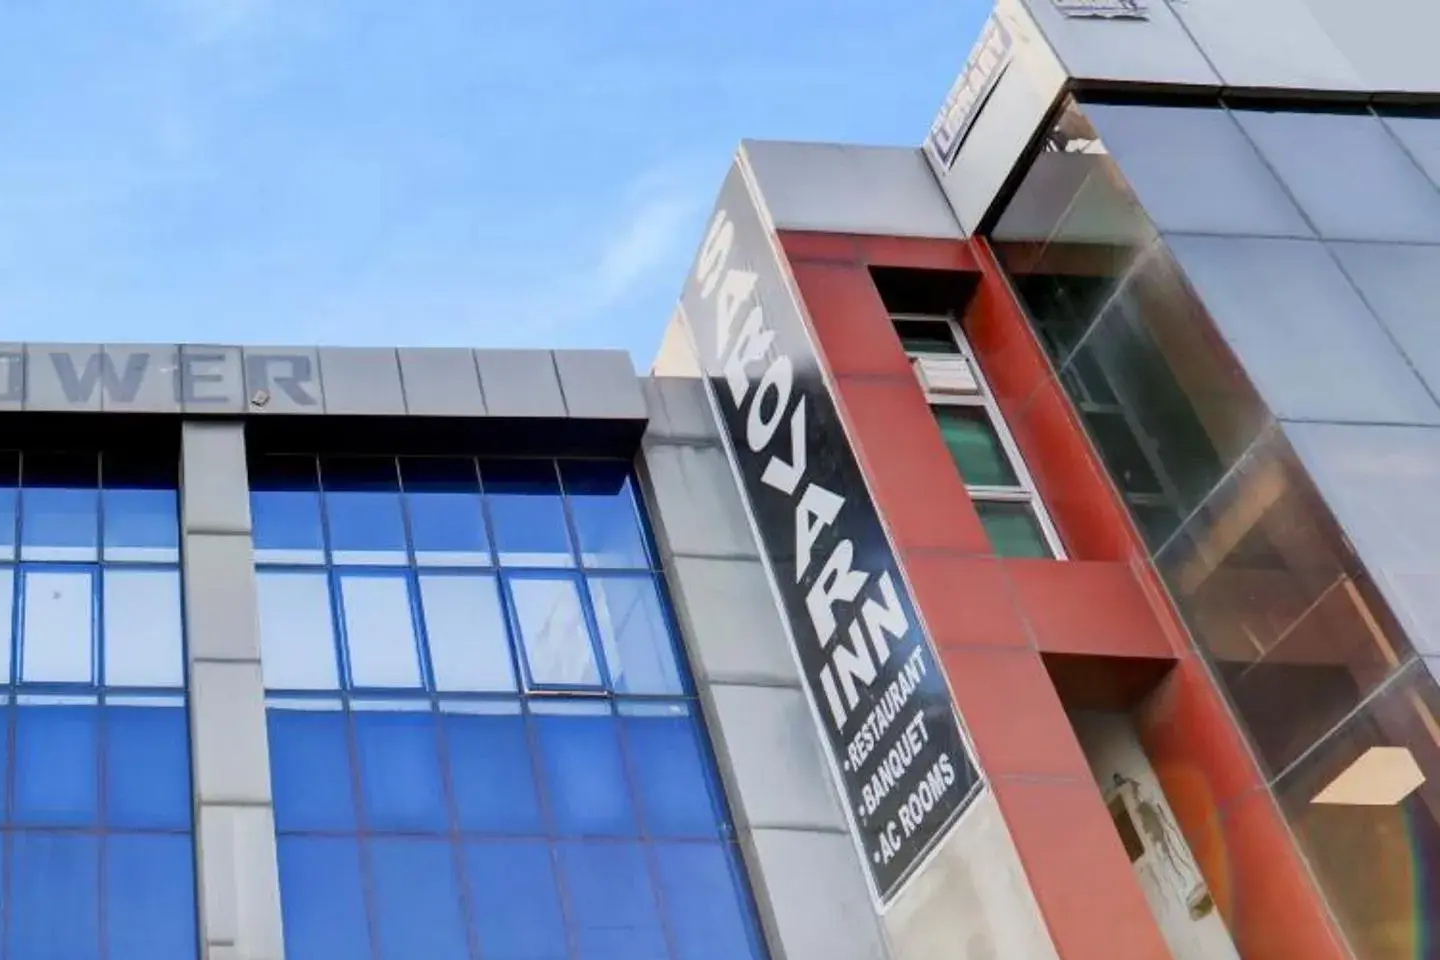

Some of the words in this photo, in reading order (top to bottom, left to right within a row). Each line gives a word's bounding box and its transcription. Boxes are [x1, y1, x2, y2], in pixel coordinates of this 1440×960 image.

[819, 570, 909, 732] INN
[846, 645, 927, 773] RESTAURANT
[861, 709, 931, 817] BANQUET
[877, 821, 902, 865] AC
[898, 752, 956, 838] ROOMS
